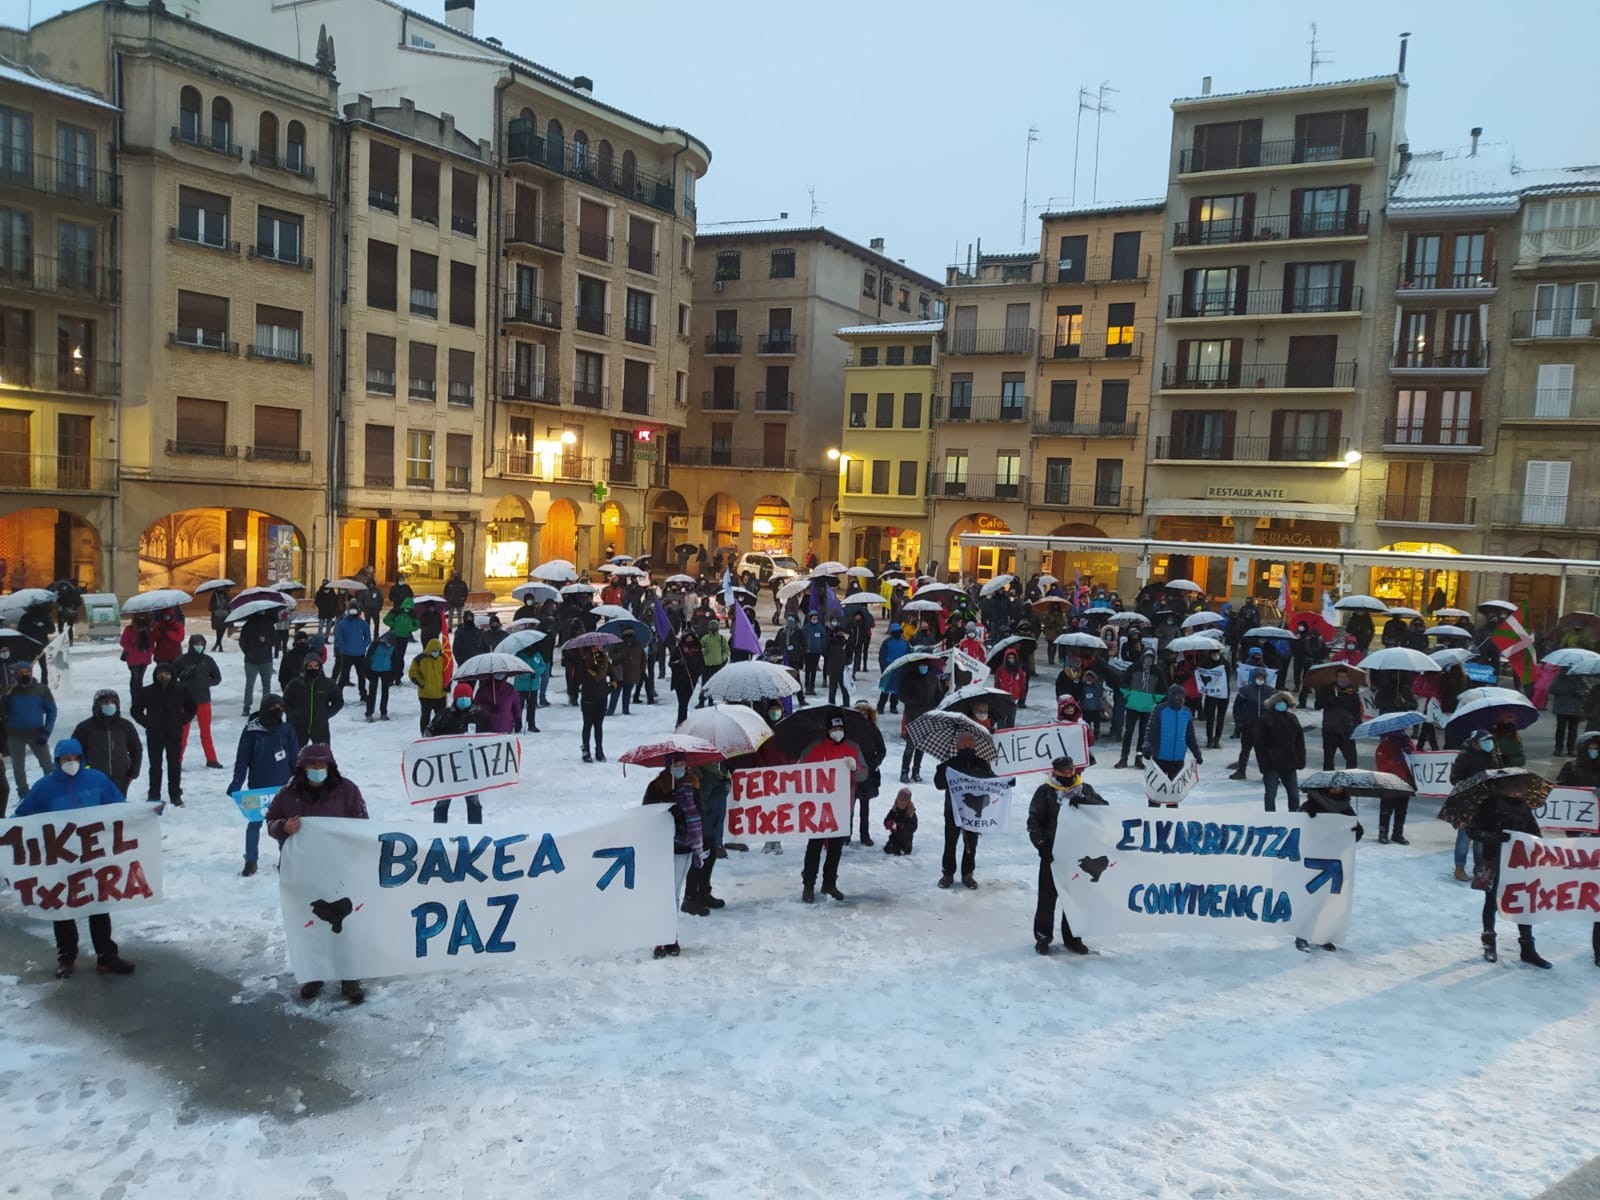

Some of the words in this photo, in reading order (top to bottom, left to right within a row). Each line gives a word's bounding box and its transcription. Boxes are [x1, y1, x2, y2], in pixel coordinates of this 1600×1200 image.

[1209, 487, 1285, 498] RESTAURANTE
[731, 767, 837, 802] FERMIN
[1535, 800, 1595, 823] OITZ
[378, 832, 565, 888] BAKEA
[1116, 818, 1301, 862] ELKARBIZITZA
[4, 860, 153, 910] TXERA
[1128, 882, 1292, 923] CONVIVENCIA
[1501, 878, 1600, 915] ETXER
[411, 893, 519, 957] PAZ
